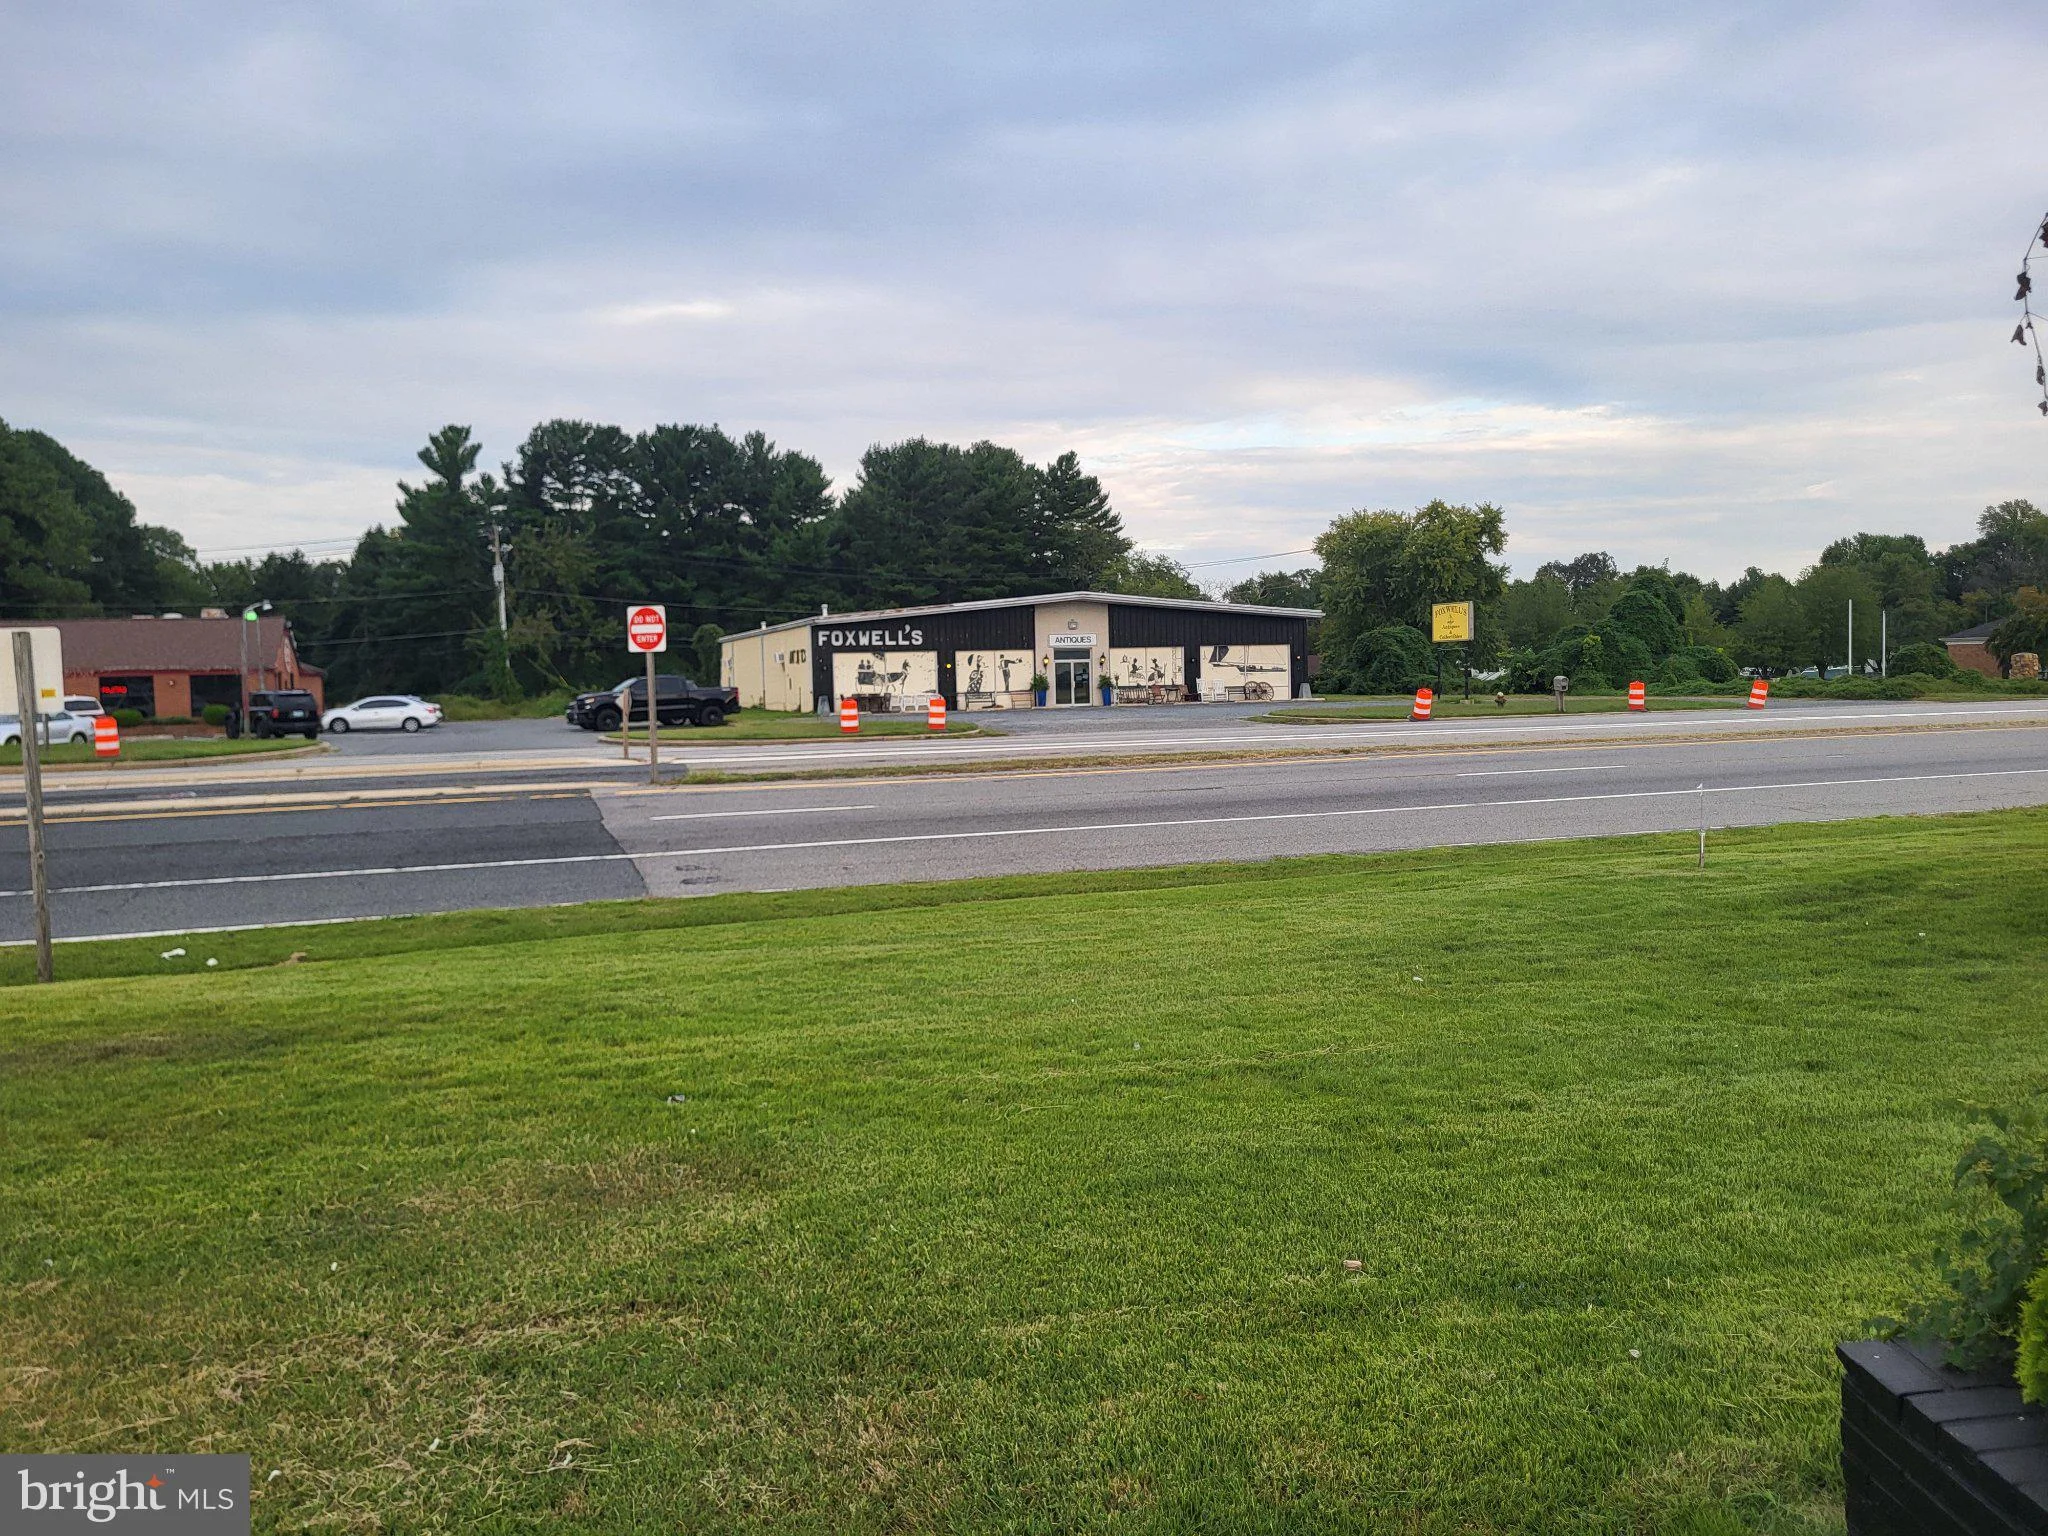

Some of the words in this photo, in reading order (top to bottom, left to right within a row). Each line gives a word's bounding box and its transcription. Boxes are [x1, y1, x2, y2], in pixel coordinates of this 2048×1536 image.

[633, 614, 644, 623] DO
[645, 614, 659, 623] NOT
[637, 634, 658, 643] ENTER
[817, 624, 923, 646] FOXWELL'S
